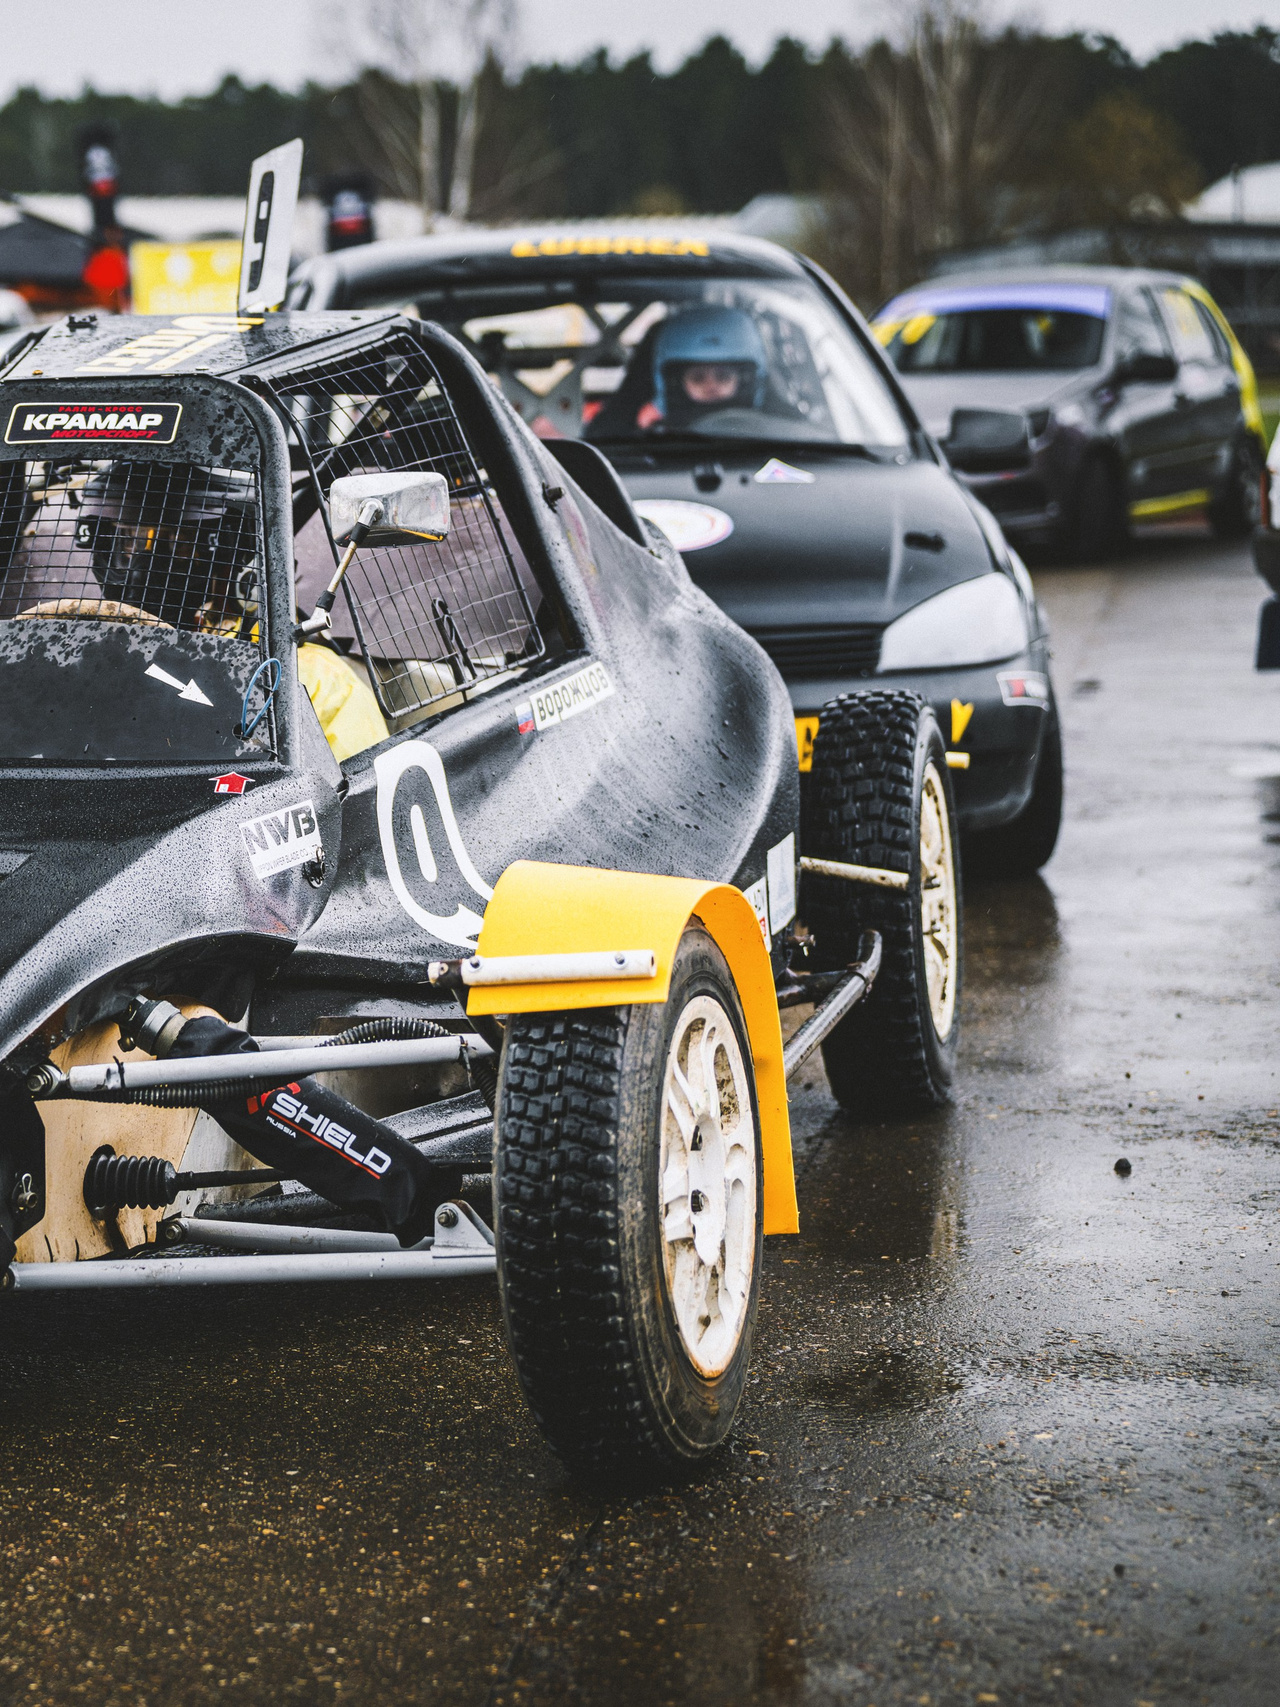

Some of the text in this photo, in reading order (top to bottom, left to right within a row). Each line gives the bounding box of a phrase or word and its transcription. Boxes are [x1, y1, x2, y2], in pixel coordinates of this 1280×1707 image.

[247, 170, 274, 293] 9
[23, 413, 163, 430] КРАМАР
[51, 430, 158, 438] МОТОРСПОРТ
[241, 805, 316, 855] NWB
[265, 1115, 297, 1139] RUSSIA
[272, 1092, 392, 1174] SHIELD
